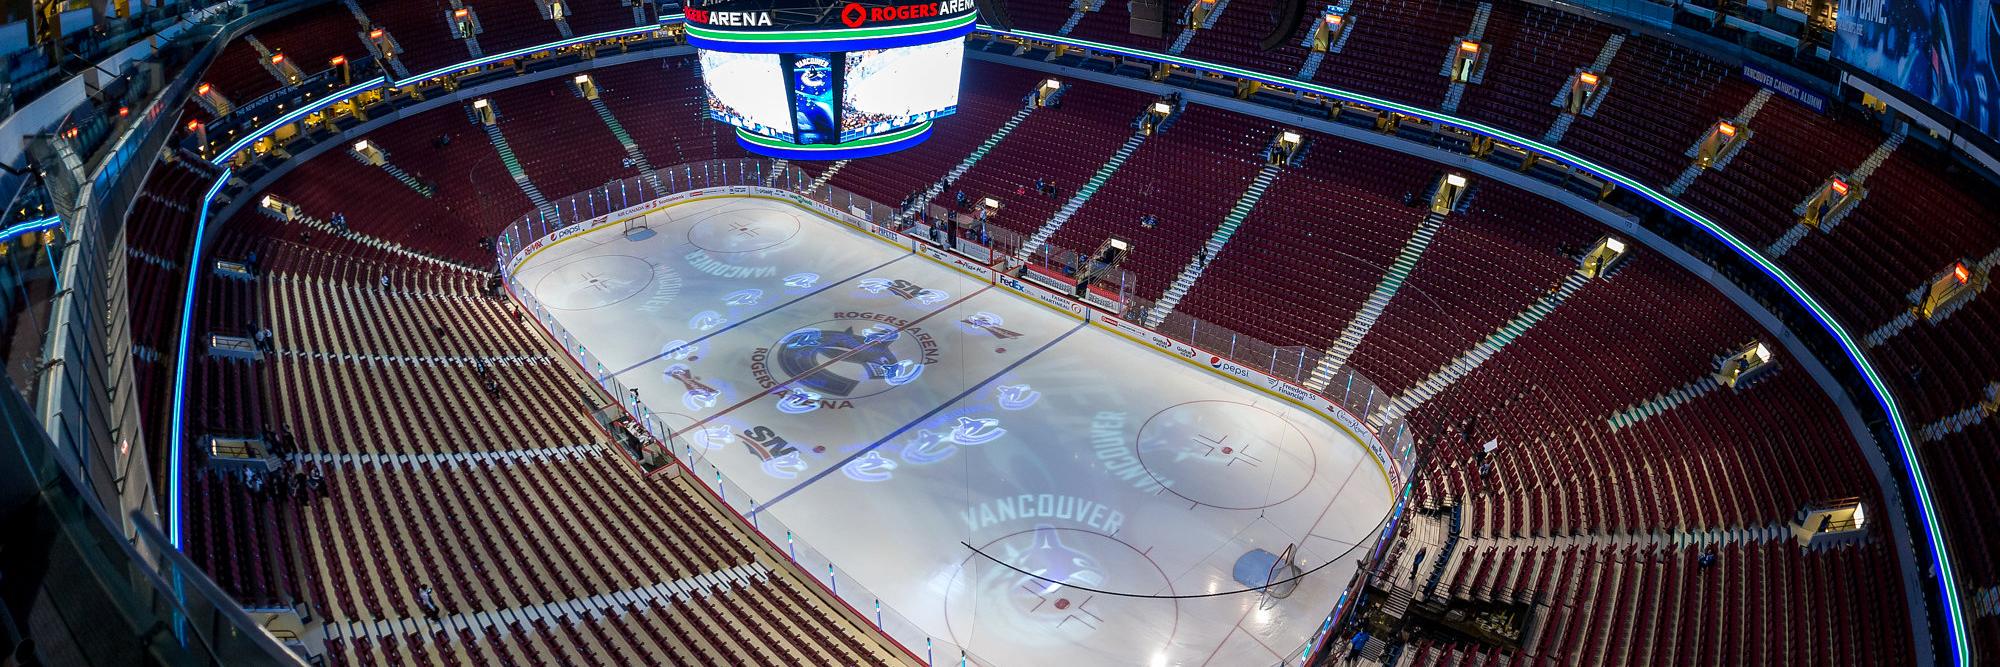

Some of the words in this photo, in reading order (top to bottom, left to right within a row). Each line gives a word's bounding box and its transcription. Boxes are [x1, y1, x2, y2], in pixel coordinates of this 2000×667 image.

[709, 11, 772, 26] ARENA
[871, 3, 938, 22] ROGERS
[940, 0, 975, 15] ARENA
[795, 57, 829, 68] VANCOUVER
[1743, 65, 1773, 87] VANCOUVER
[1773, 79, 1800, 98] CANUCKS
[1800, 91, 1822, 110] ALUMNI
[246, 104, 256, 112] NEW
[256, 96, 269, 106] HOME
[269, 93, 276, 101] OF
[277, 89, 287, 97] THE
[625, 205, 644, 215] CANADA
[559, 224, 580, 238] pepsi
[962, 261, 976, 271] Pizza
[1000, 275, 1024, 292] FedEx
[1040, 295, 1070, 310] MARTINEAU
[1051, 294, 1071, 305] FASKEN
[834, 311, 908, 326] ROGERS
[907, 327, 939, 365] ARENA
[1153, 336, 1168, 346] Global
[1177, 346, 1192, 355] Global
[751, 347, 776, 389] ROGERS
[1223, 363, 1249, 377] pepsi
[1279, 386, 1304, 400] Financial
[1282, 382, 1310, 398] Freedom
[743, 425, 801, 459] SN
[1091, 411, 1176, 496] VANCOUVER
[960, 494, 1126, 536] VANCOUVER
